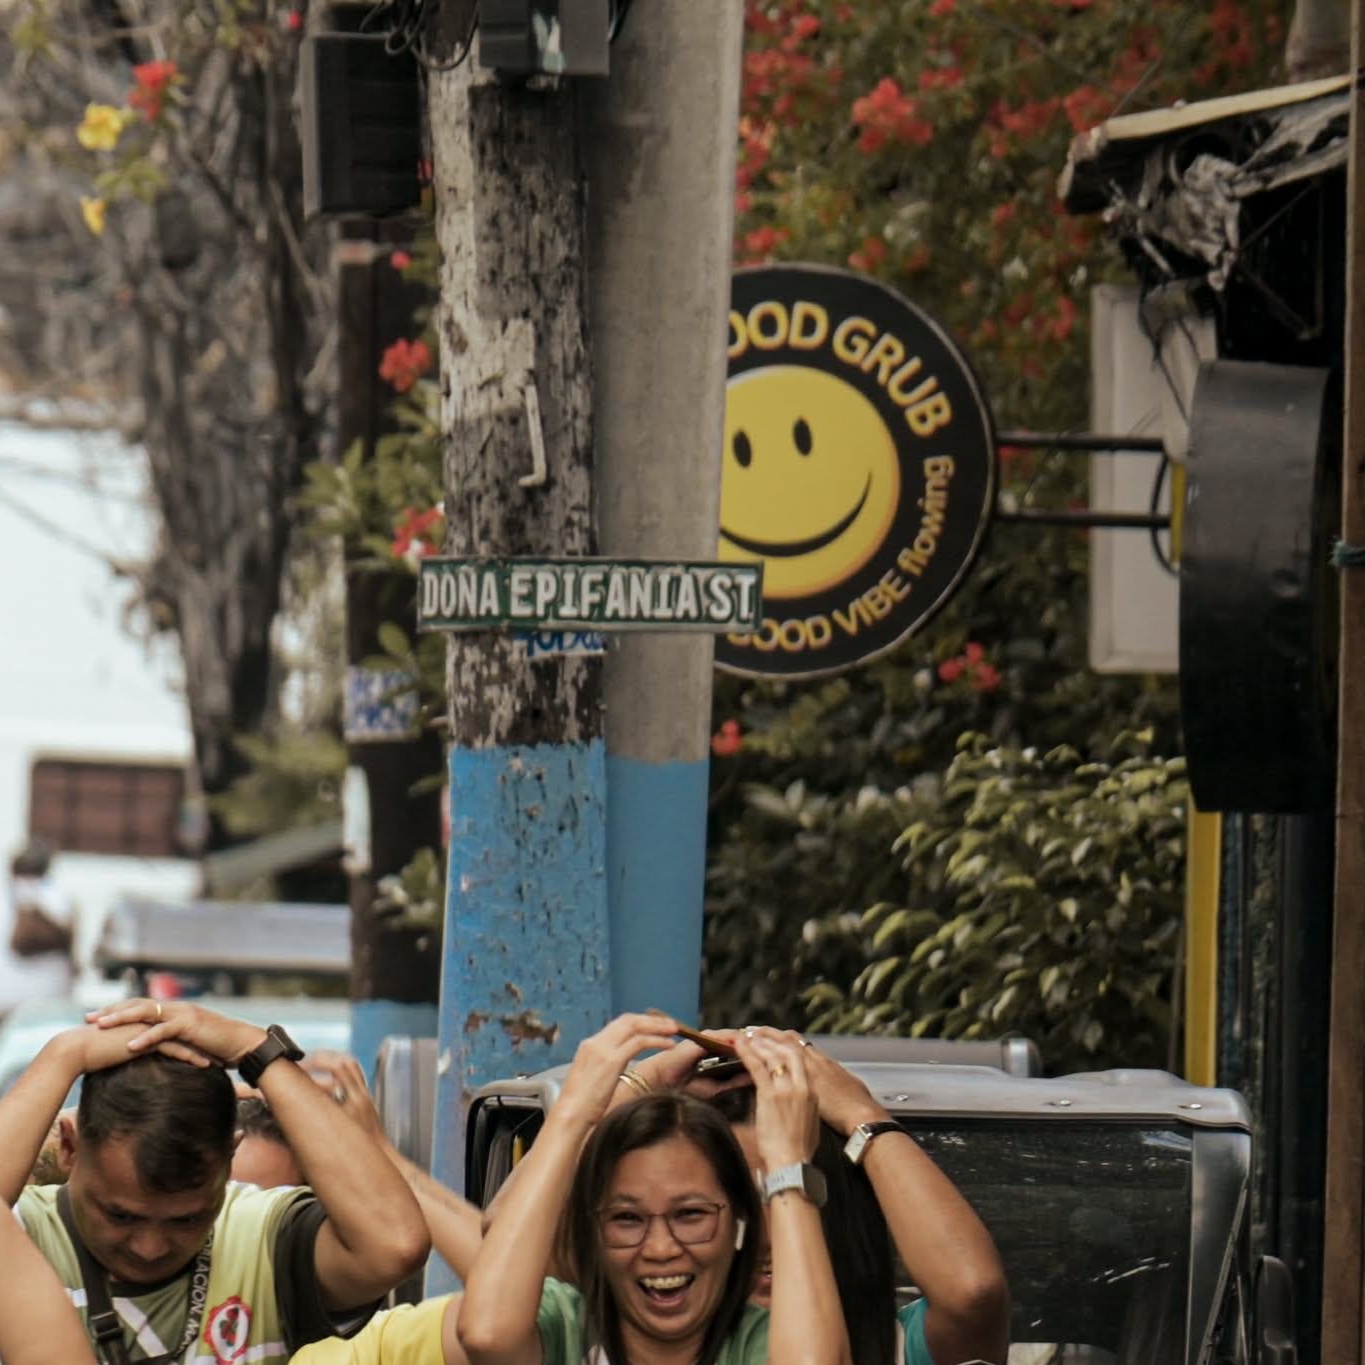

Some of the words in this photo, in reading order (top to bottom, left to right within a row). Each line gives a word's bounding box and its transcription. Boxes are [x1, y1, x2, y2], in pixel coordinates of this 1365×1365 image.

[728, 301, 829, 357] OOD
[833, 316, 952, 437] GRUB
[510, 570, 699, 619] EPIFANIA
[832, 568, 912, 636] VIBE
[897, 454, 955, 577] flowing
